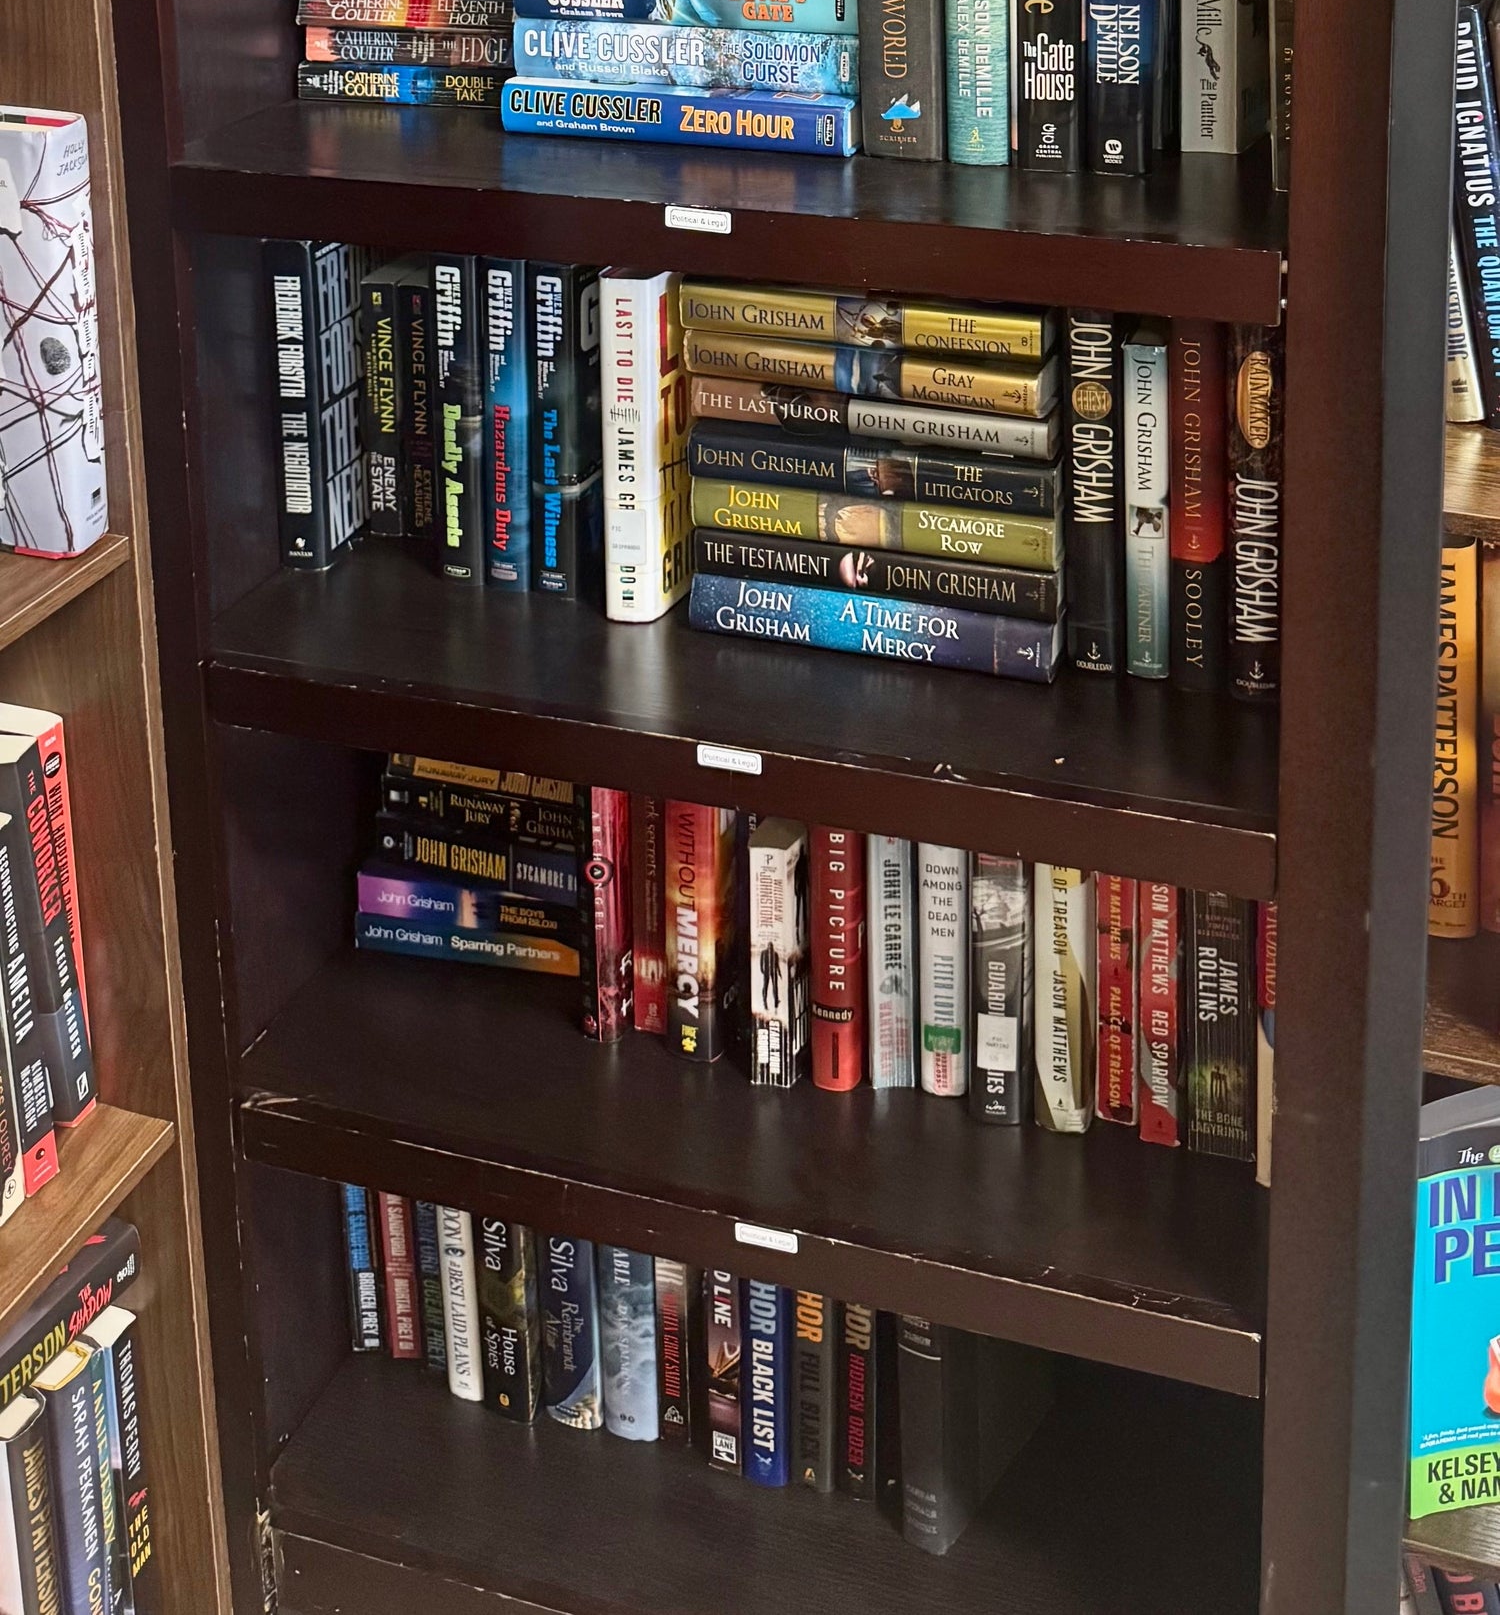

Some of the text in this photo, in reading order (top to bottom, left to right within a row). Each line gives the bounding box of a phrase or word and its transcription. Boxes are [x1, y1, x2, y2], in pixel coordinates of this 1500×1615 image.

[742, 41, 820, 63] SOLOMON
[1036, 33, 1074, 71] Gate
[742, 61, 799, 84] CURSE
[1024, 68, 1074, 101] House
[510, 90, 662, 124] CLIVE CUSSLER
[680, 105, 794, 139] ZERO HOUR
[1200, 93, 1215, 139] Panther
[556, 120, 635, 134] Graham Brown
[1455, 101, 1495, 207] IGNATIUS
[689, 299, 825, 330] JOHN GRISHAM
[378, 318, 395, 433] VINCE FLYNN
[615, 298, 635, 484] LAST TO DIE JAMES
[739, 396, 840, 423] LAST JUROR
[371, 466, 385, 511] STATE
[384, 456, 397, 511] ENEMY
[494, 406, 511, 551] Hazardous Duty
[925, 483, 1013, 505] LITIGATORS
[919, 511, 1005, 538] SYCAMORE
[705, 541, 830, 577] THE TESTAMENT
[941, 535, 983, 555] ROW
[839, 603, 960, 639] A TIME FOR
[1185, 570, 1203, 668] SOOLEY
[862, 630, 936, 662] MERCY
[1076, 661, 1113, 671] DOUBLEDAY
[1432, 669, 1460, 840] PATTERSON
[26, 795, 55, 926] COWORKER
[926, 864, 959, 875] DOWN
[922, 880, 962, 891] AMONG
[932, 896, 953, 906] THE
[829, 833, 845, 991] BIG PICTURE
[928, 911, 957, 922] DEAD
[450, 937, 560, 961] Sparring Partners
[931, 927, 955, 937] MEN
[676, 906, 699, 1019] MERCY
[7, 953, 35, 1044] AMELIA
[54, 936, 80, 1061] FREIDA McFADDEN
[1198, 946, 1218, 1022] ROLLINS
[1219, 959, 1238, 1017] JAMES
[812, 1004, 853, 1021] Kennedy
[1152, 1010, 1168, 1108] RED SPARROW
[482, 1218, 507, 1272] Silva
[359, 1272, 379, 1342] BROKEN PREY
[502, 1327, 517, 1375] House
[118, 1339, 142, 1480] THOMAS PERRY
[753, 1338, 774, 1452] BLACK LIST
[72, 1387, 99, 1562] SARAH PEKKANEN
[129, 1505, 148, 1537] THE
[131, 1533, 150, 1559] OLD
[132, 1548, 152, 1578] MAN
